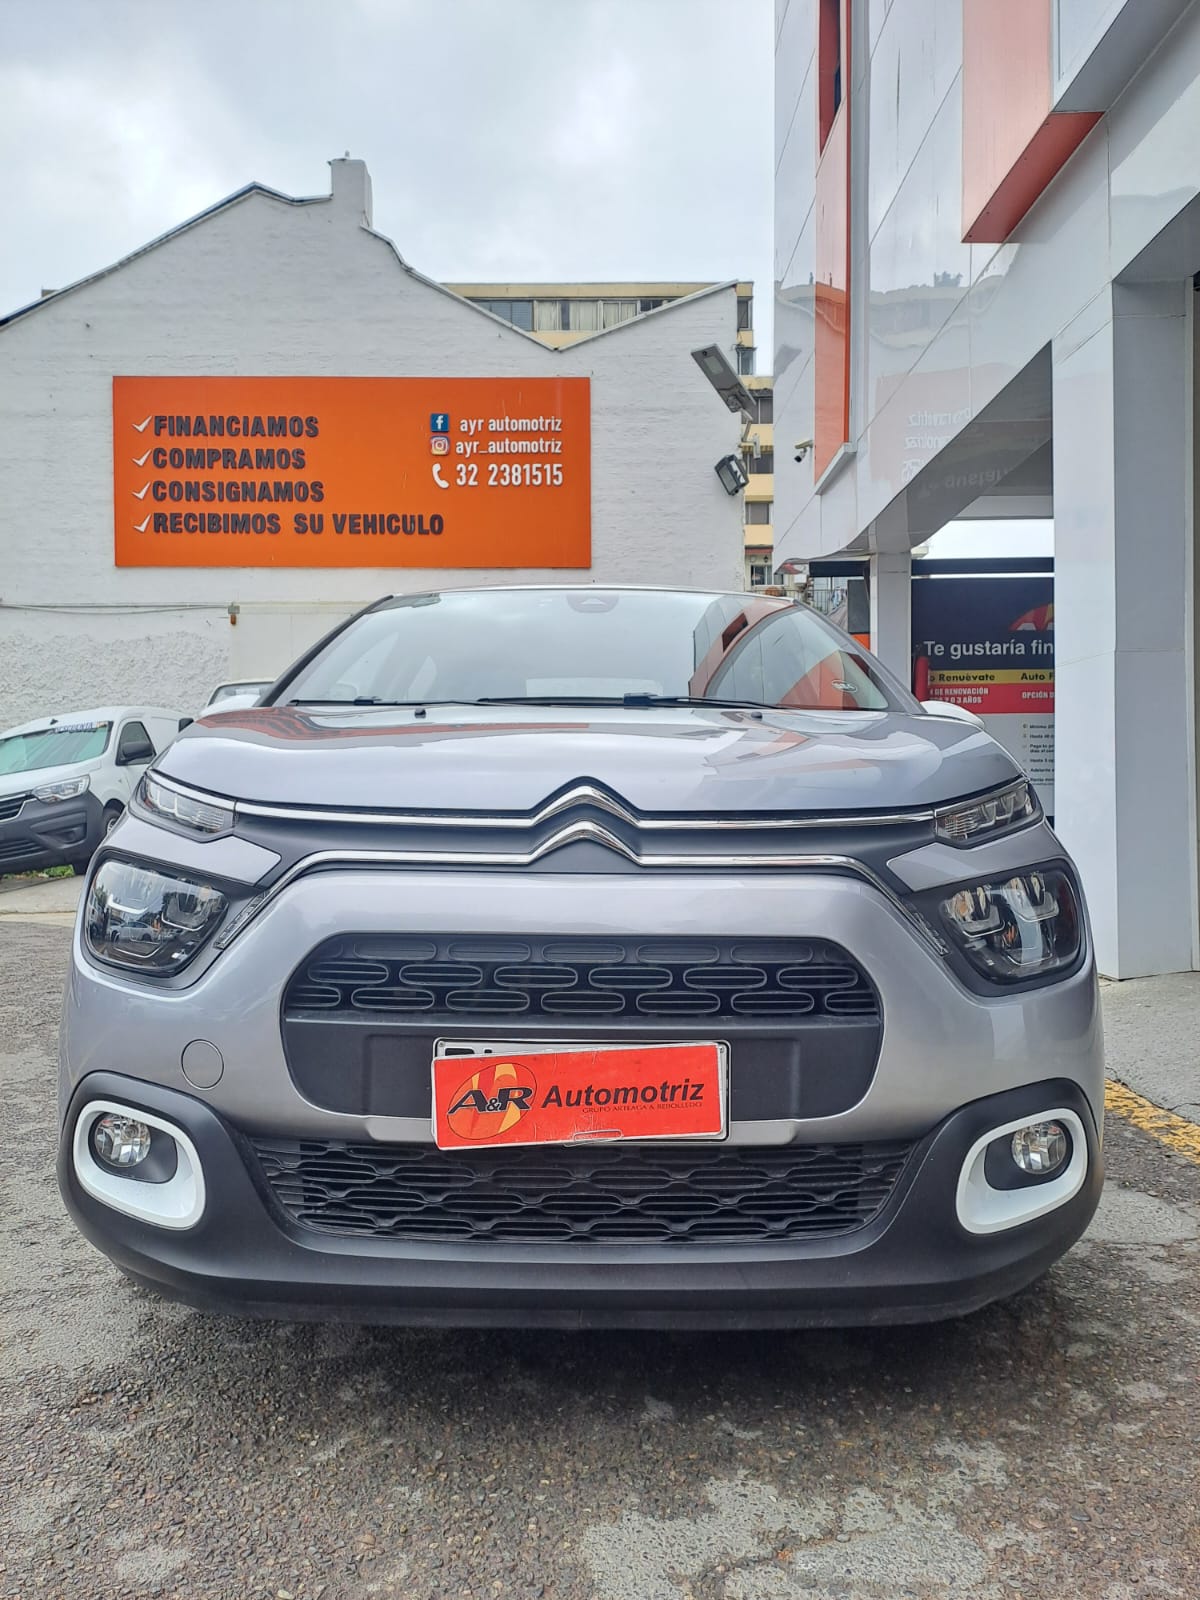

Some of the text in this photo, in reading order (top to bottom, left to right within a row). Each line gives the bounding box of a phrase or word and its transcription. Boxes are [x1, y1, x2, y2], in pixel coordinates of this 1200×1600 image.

[153, 415, 320, 438] FINANCIAMOS
[460, 415, 562, 436] ayr automotriz
[152, 447, 306, 470] COMPRAMOS
[455, 437, 562, 458] ayr_automotriz
[456, 463, 563, 486] 32 2381515
[152, 480, 325, 503] CONSIGNAMOS
[153, 512, 444, 536] RECIBIMOS SU VEHICULO
[923, 640, 945, 656] Te
[950, 638, 1025, 660] gustaría
[1020, 672, 1045, 681] Auto
[447, 1086, 534, 1116] A&R
[541, 1079, 705, 1109] Automotriz
[582, 1105, 611, 1114] GRUPO
